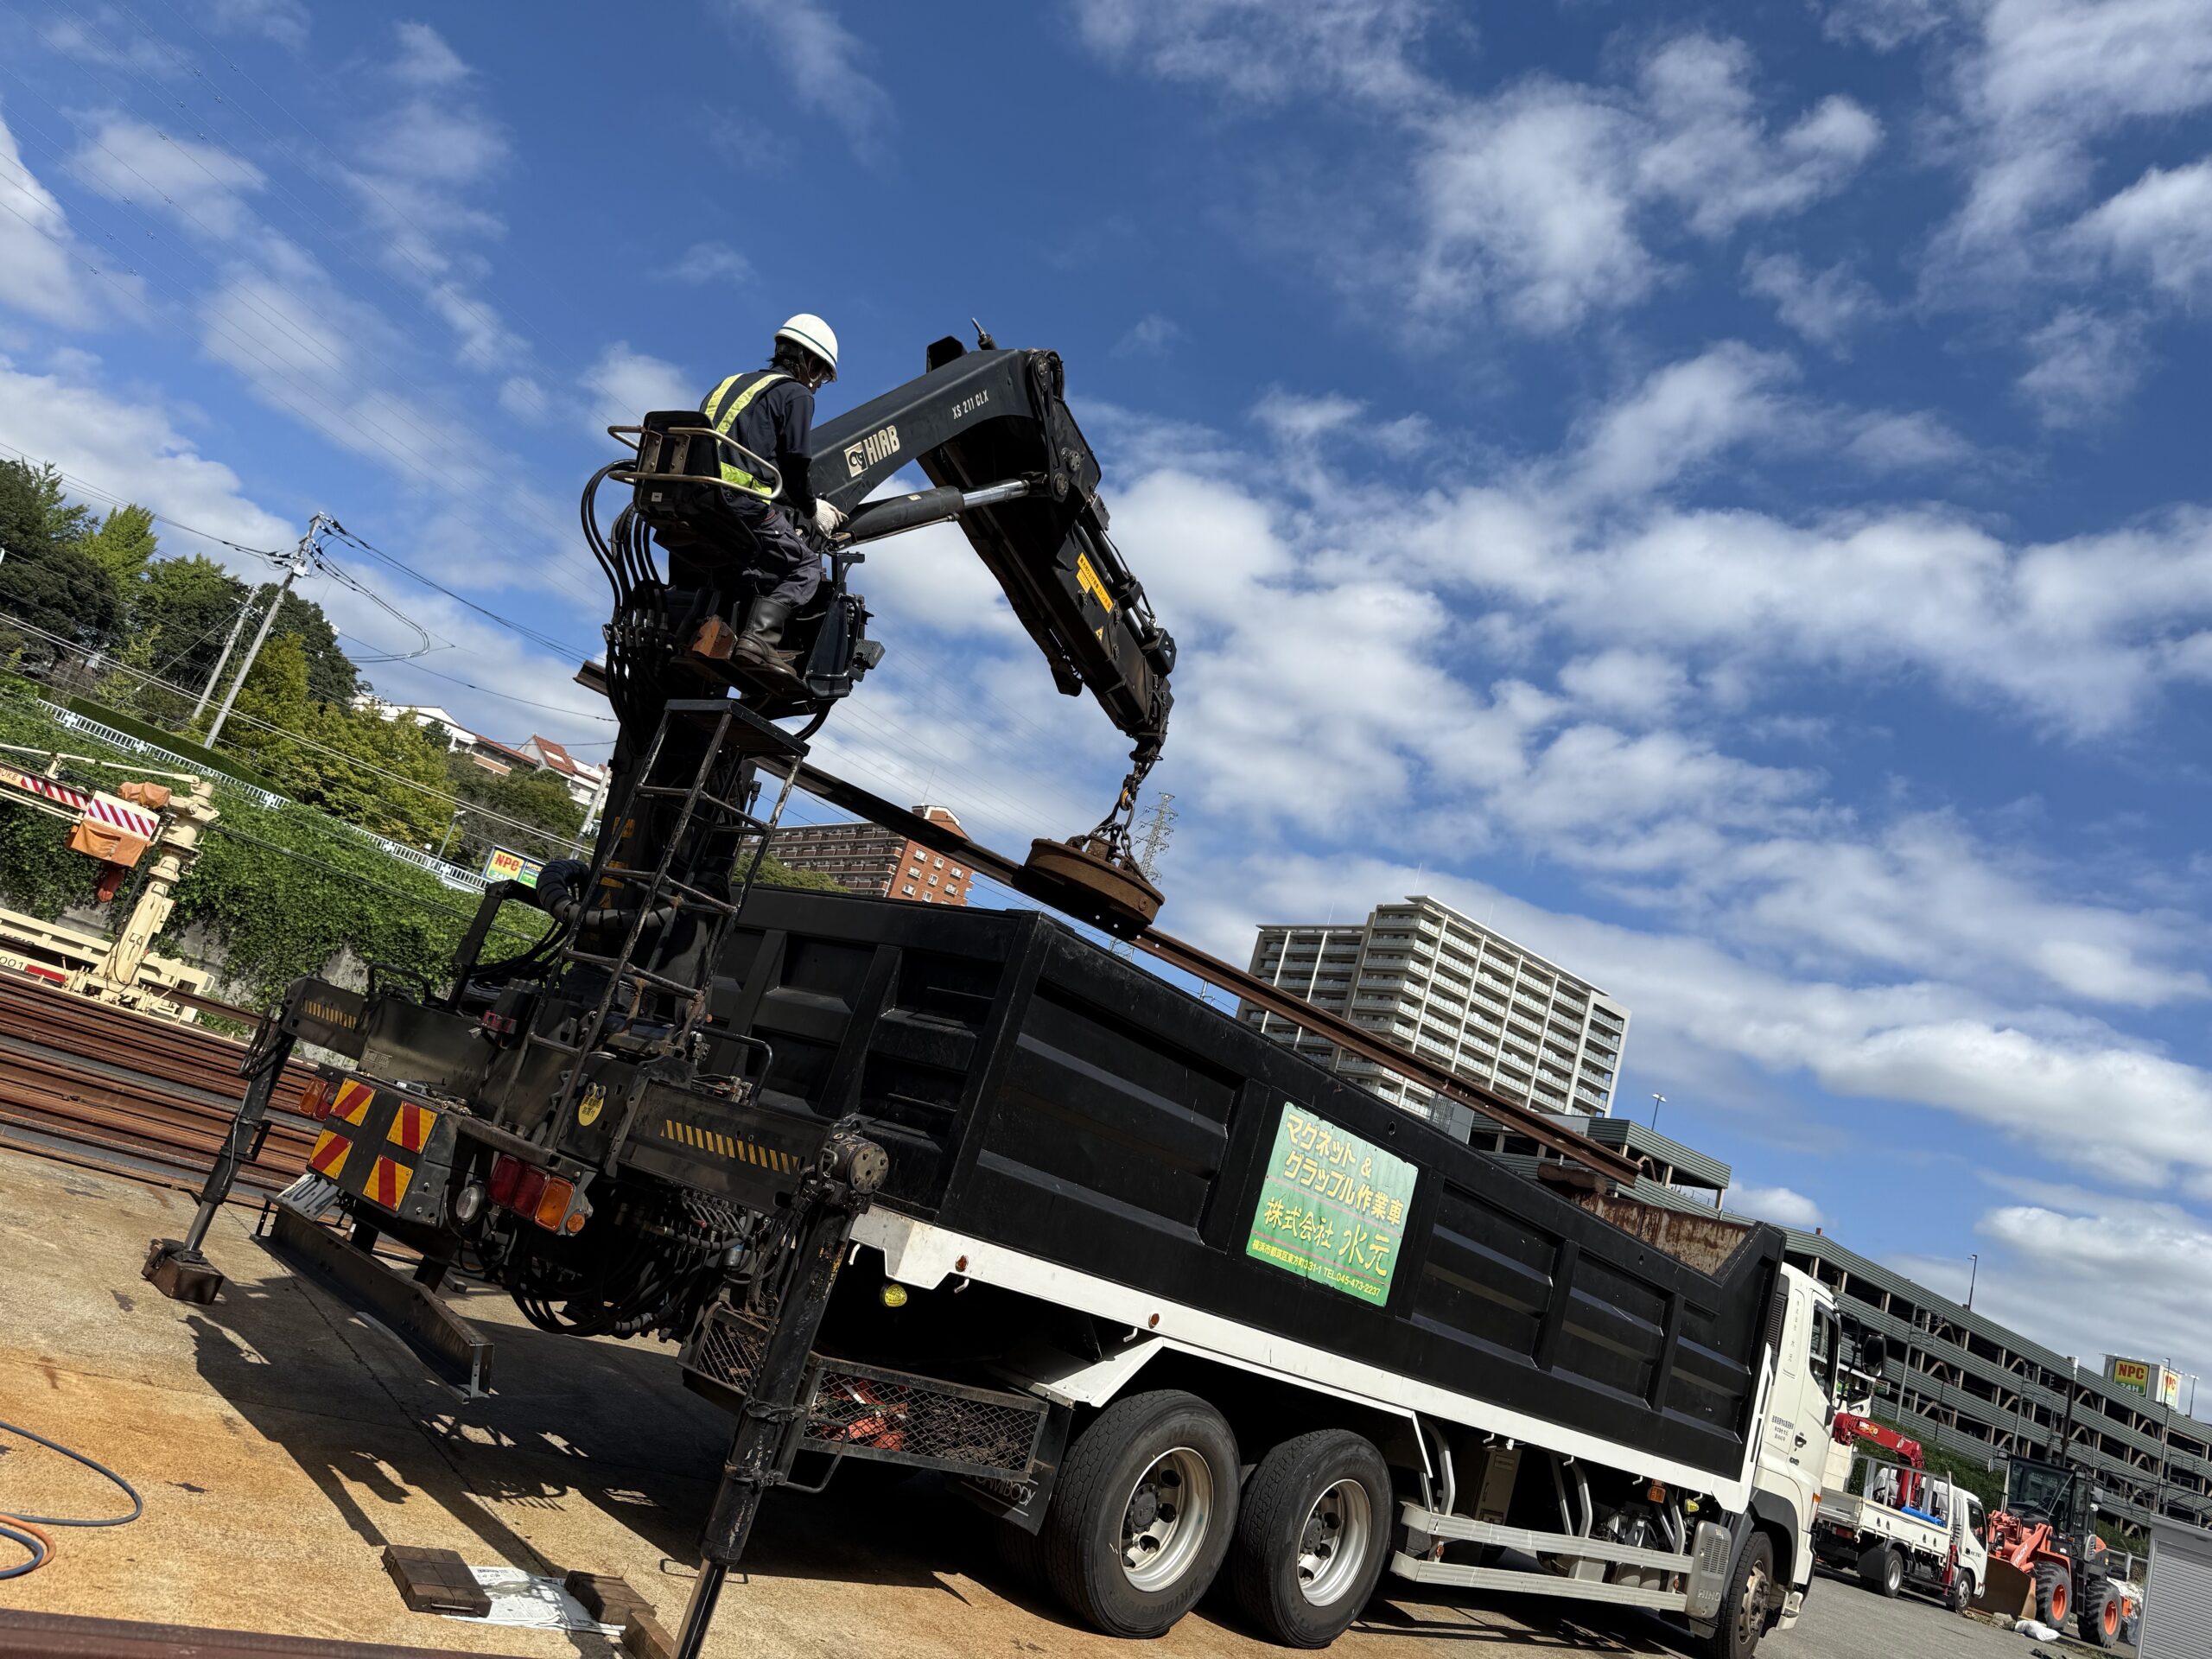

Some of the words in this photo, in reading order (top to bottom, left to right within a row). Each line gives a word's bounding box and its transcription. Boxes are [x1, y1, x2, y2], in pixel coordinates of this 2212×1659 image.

[951, 404, 963, 420] XS
[963, 399, 976, 414] 211
[975, 389, 989, 408] CLX
[862, 424, 900, 466] HIAB
[1285, 1113, 1356, 1168] マグネット
[1361, 1156, 1373, 1179] &
[1284, 1150, 1404, 1226] グラップル作業車
[1264, 1197, 1333, 1250] 株式会社
[1338, 1224, 1390, 1277] 水元
[2118, 1363, 2145, 1380] NPC
[1698, 1589, 1721, 1602] HINO
